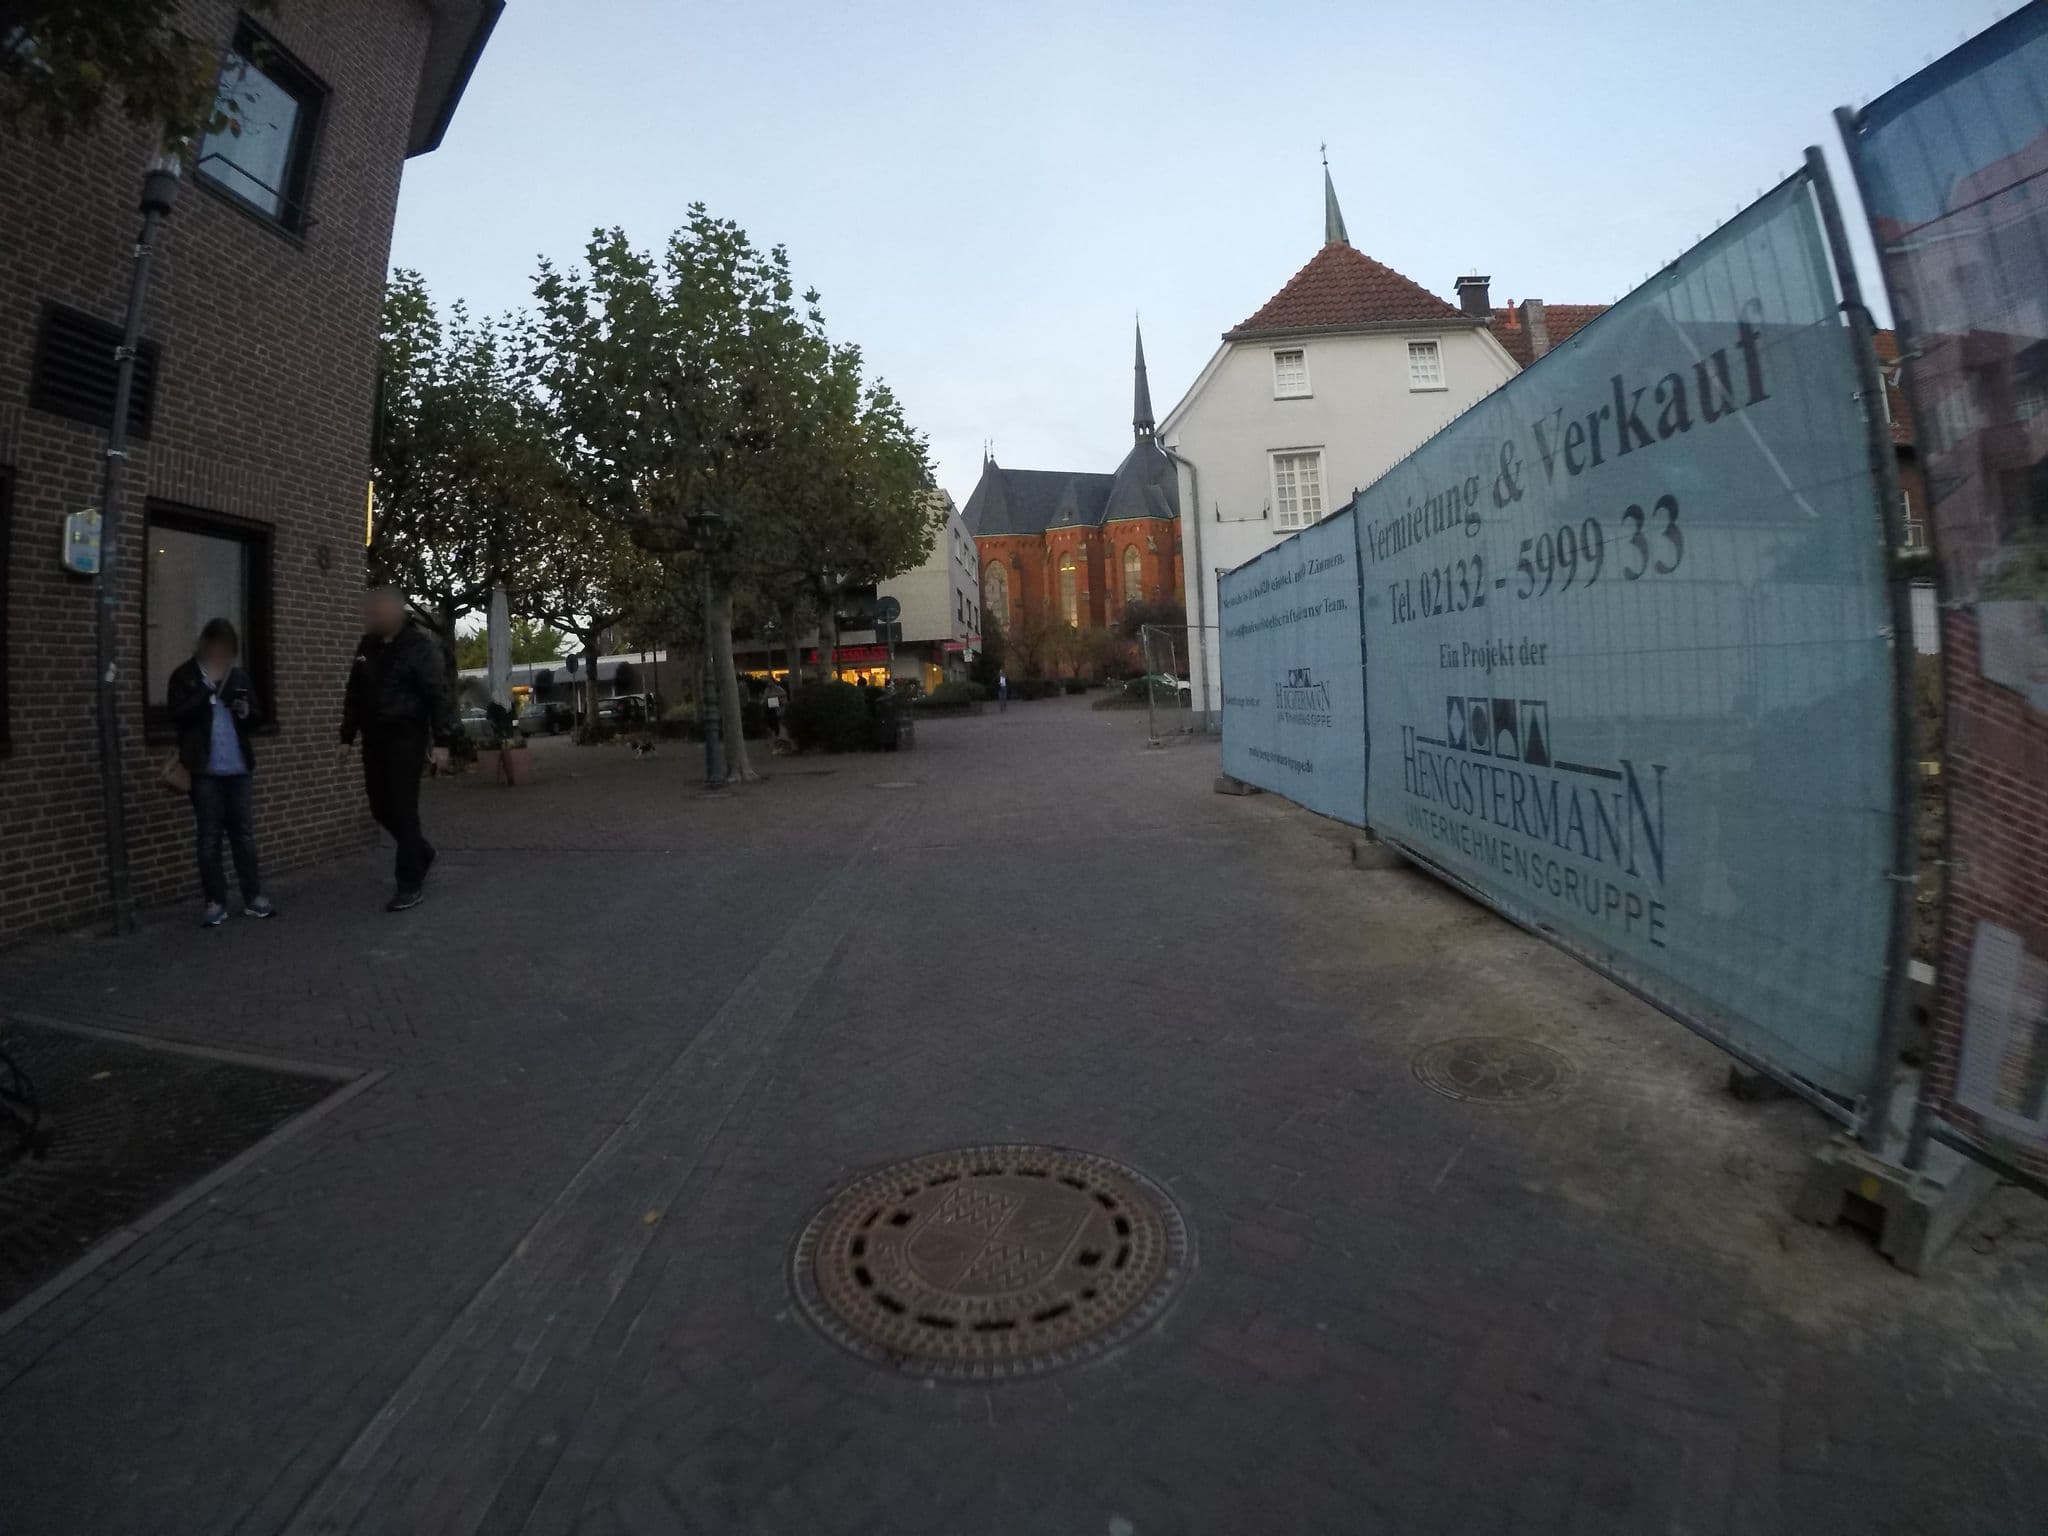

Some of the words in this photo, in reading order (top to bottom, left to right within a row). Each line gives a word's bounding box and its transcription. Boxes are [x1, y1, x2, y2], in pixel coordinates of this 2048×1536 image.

[1367, 474, 1481, 565] Vermietung
[1493, 440, 1525, 508] &
[1532, 296, 1771, 486] Verkauf
[1389, 579, 1416, 624] Tel.
[1421, 554, 1485, 618] 02132
[1517, 517, 1604, 600] 5999
[1621, 494, 1685, 581] 33
[1440, 643, 1459, 669] Ein
[1462, 639, 1515, 675] Projekt
[1519, 636, 1547, 667] der
[1400, 725, 1668, 888] HENGSTERMANN
[1405, 803, 1667, 949] UNTERNEHMENSGRUPPE
